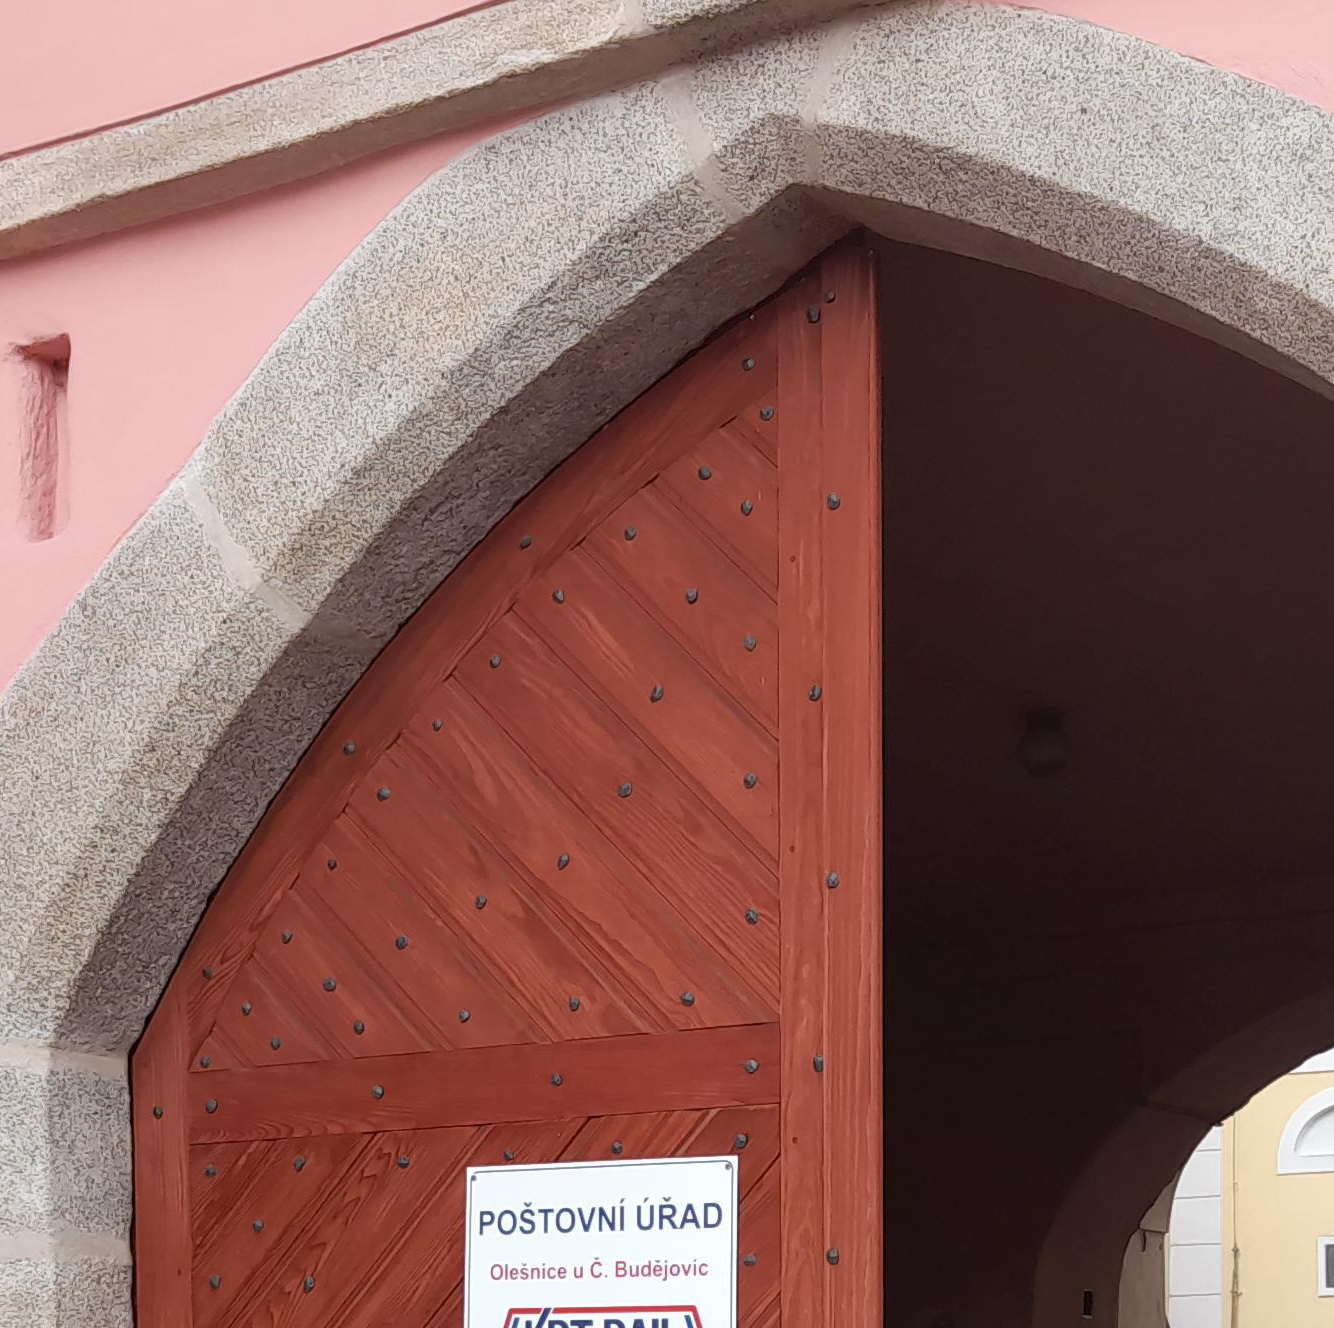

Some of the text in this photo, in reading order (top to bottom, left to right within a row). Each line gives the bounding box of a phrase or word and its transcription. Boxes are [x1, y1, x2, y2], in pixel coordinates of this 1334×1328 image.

[479, 1196, 723, 1236] POŠTOVNÍ ÚŘAD
[490, 1257, 709, 1282] Olešnice u Č. Budějovic
